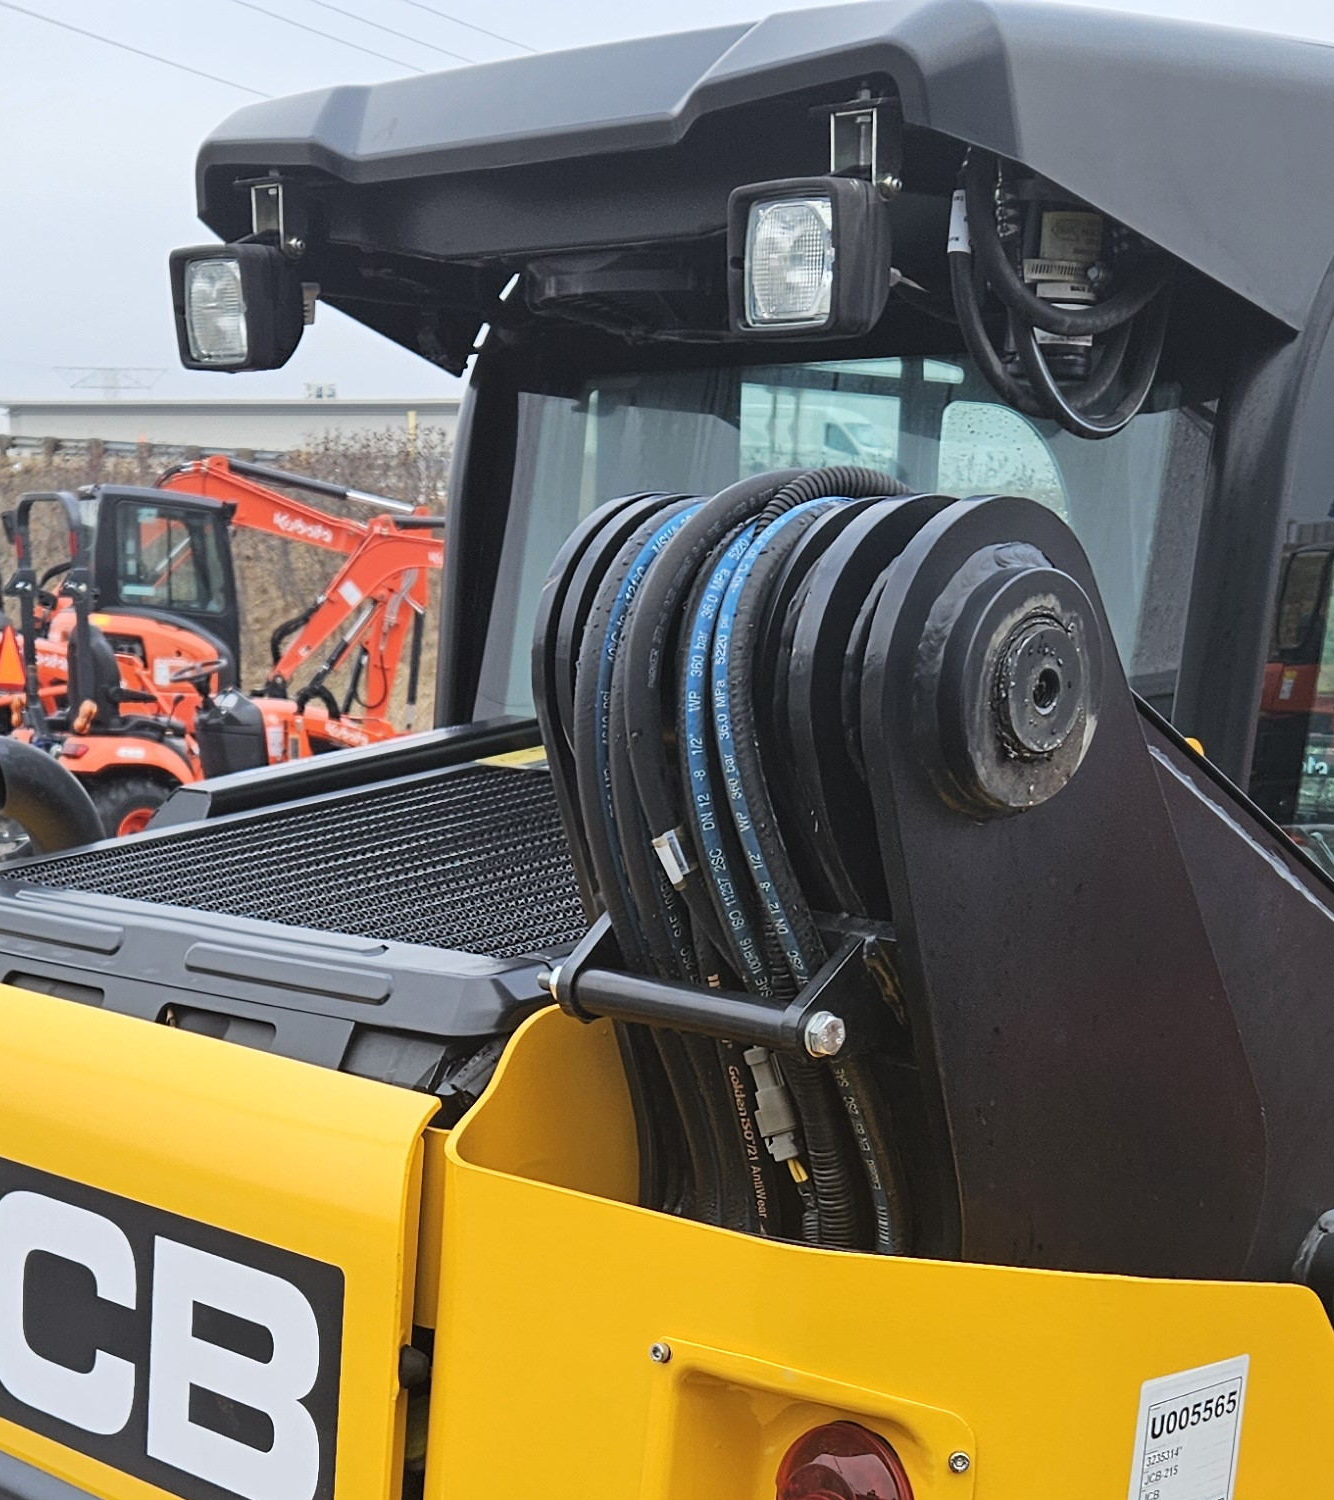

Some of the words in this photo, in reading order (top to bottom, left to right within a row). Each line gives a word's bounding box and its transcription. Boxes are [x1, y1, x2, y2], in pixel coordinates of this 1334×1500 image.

[273, 511, 333, 543] Kubota
[728, 538, 749, 561] 5220
[710, 567, 730, 592] MPa
[701, 594, 718, 619] 36.0
[695, 629, 708, 651] bar
[715, 634, 728, 665] 5220
[690, 654, 704, 678] 360
[688, 691, 701, 712] WP
[714, 679, 727, 708] MPa
[717, 713, 730, 740] 36.0
[724, 753, 736, 773] bar
[693, 769, 706, 782] -8
[728, 777, 743, 800] 360
[697, 793, 710, 808] 12
[700, 811, 715, 831] DN
[735, 811, 751, 833] WP
[709, 848, 726, 872] 2SC
[717, 878, 737, 907] 11237
[767, 901, 781, 915] 12
[728, 909, 745, 931] ISO
[775, 918, 789, 935] DN
[1151, 1390, 1237, 1439] U005565
[1144, 1464, 1178, 1485] JCB-215
